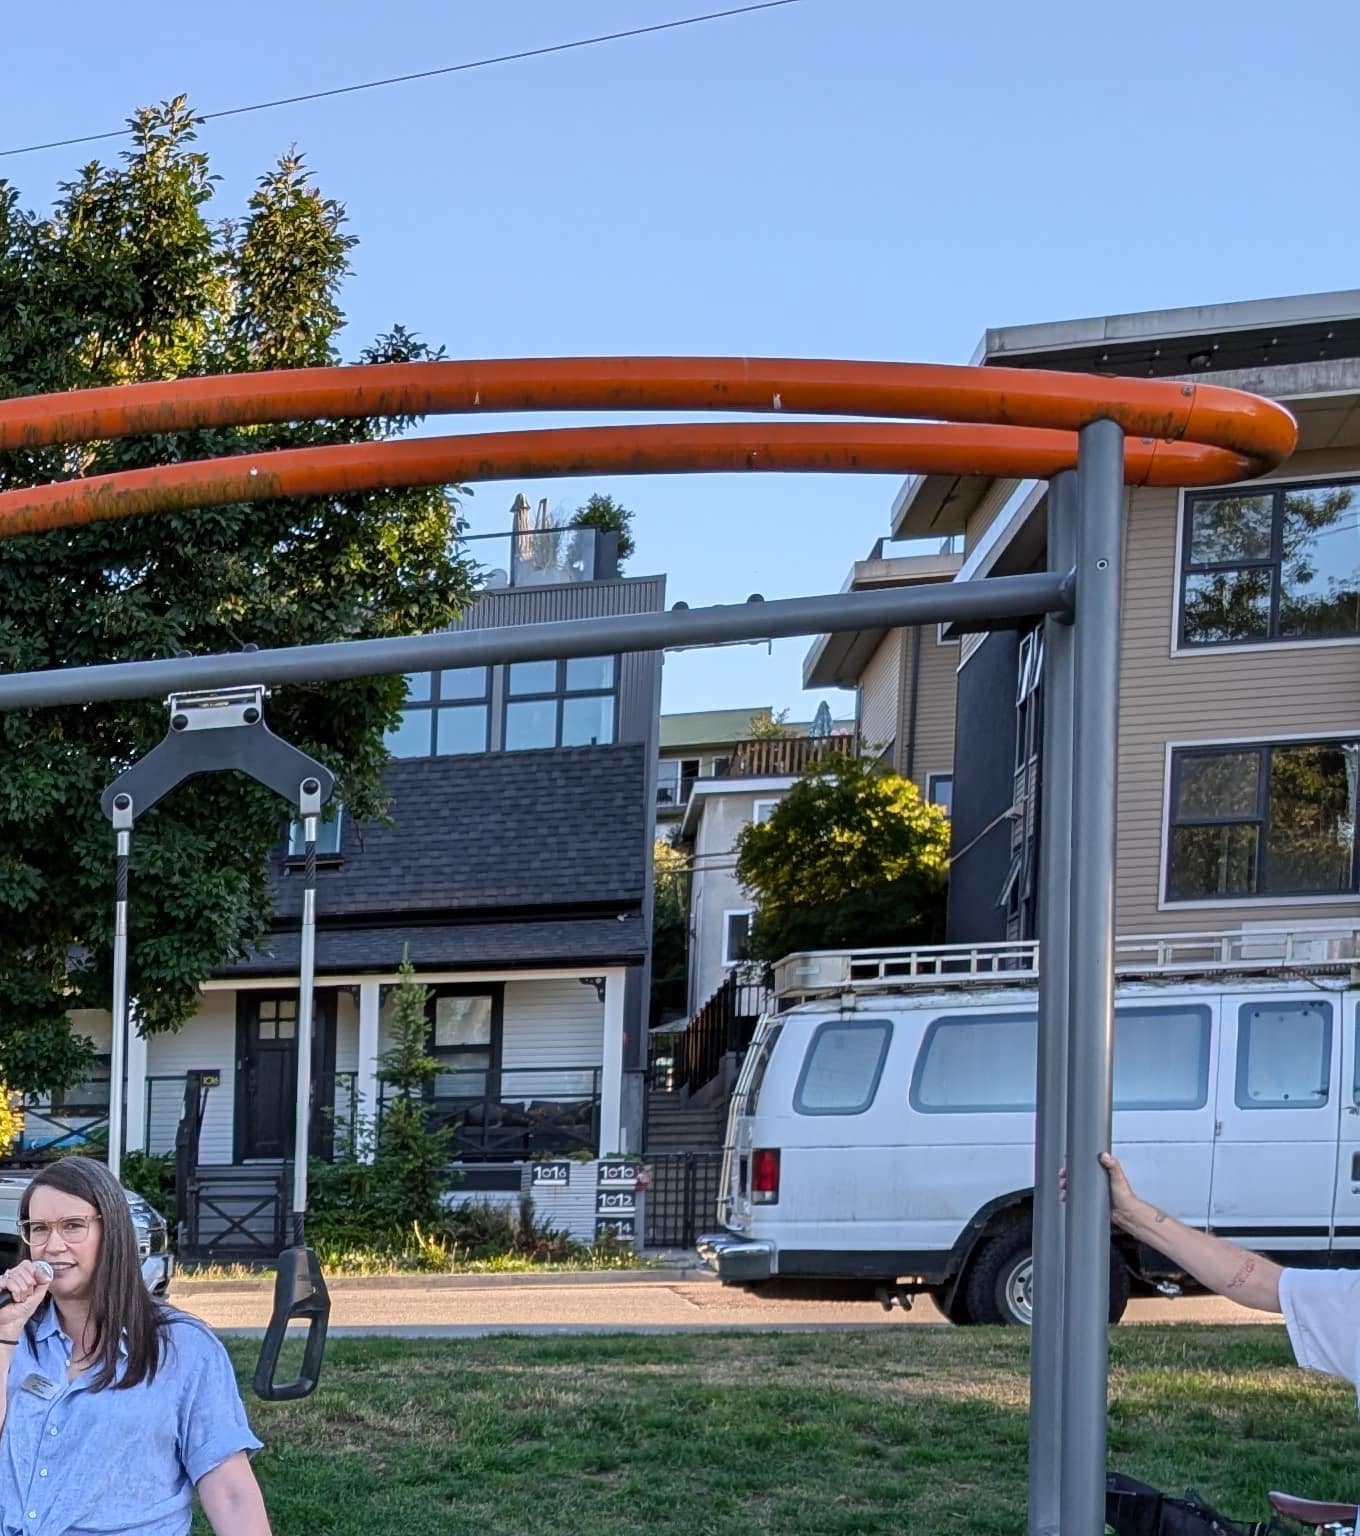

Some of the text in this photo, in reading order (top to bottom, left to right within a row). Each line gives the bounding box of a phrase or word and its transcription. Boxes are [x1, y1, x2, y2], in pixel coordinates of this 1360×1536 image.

[533, 1165, 567, 1180] 1016
[599, 1165, 634, 1179] 1010
[598, 1192, 633, 1207] 1012
